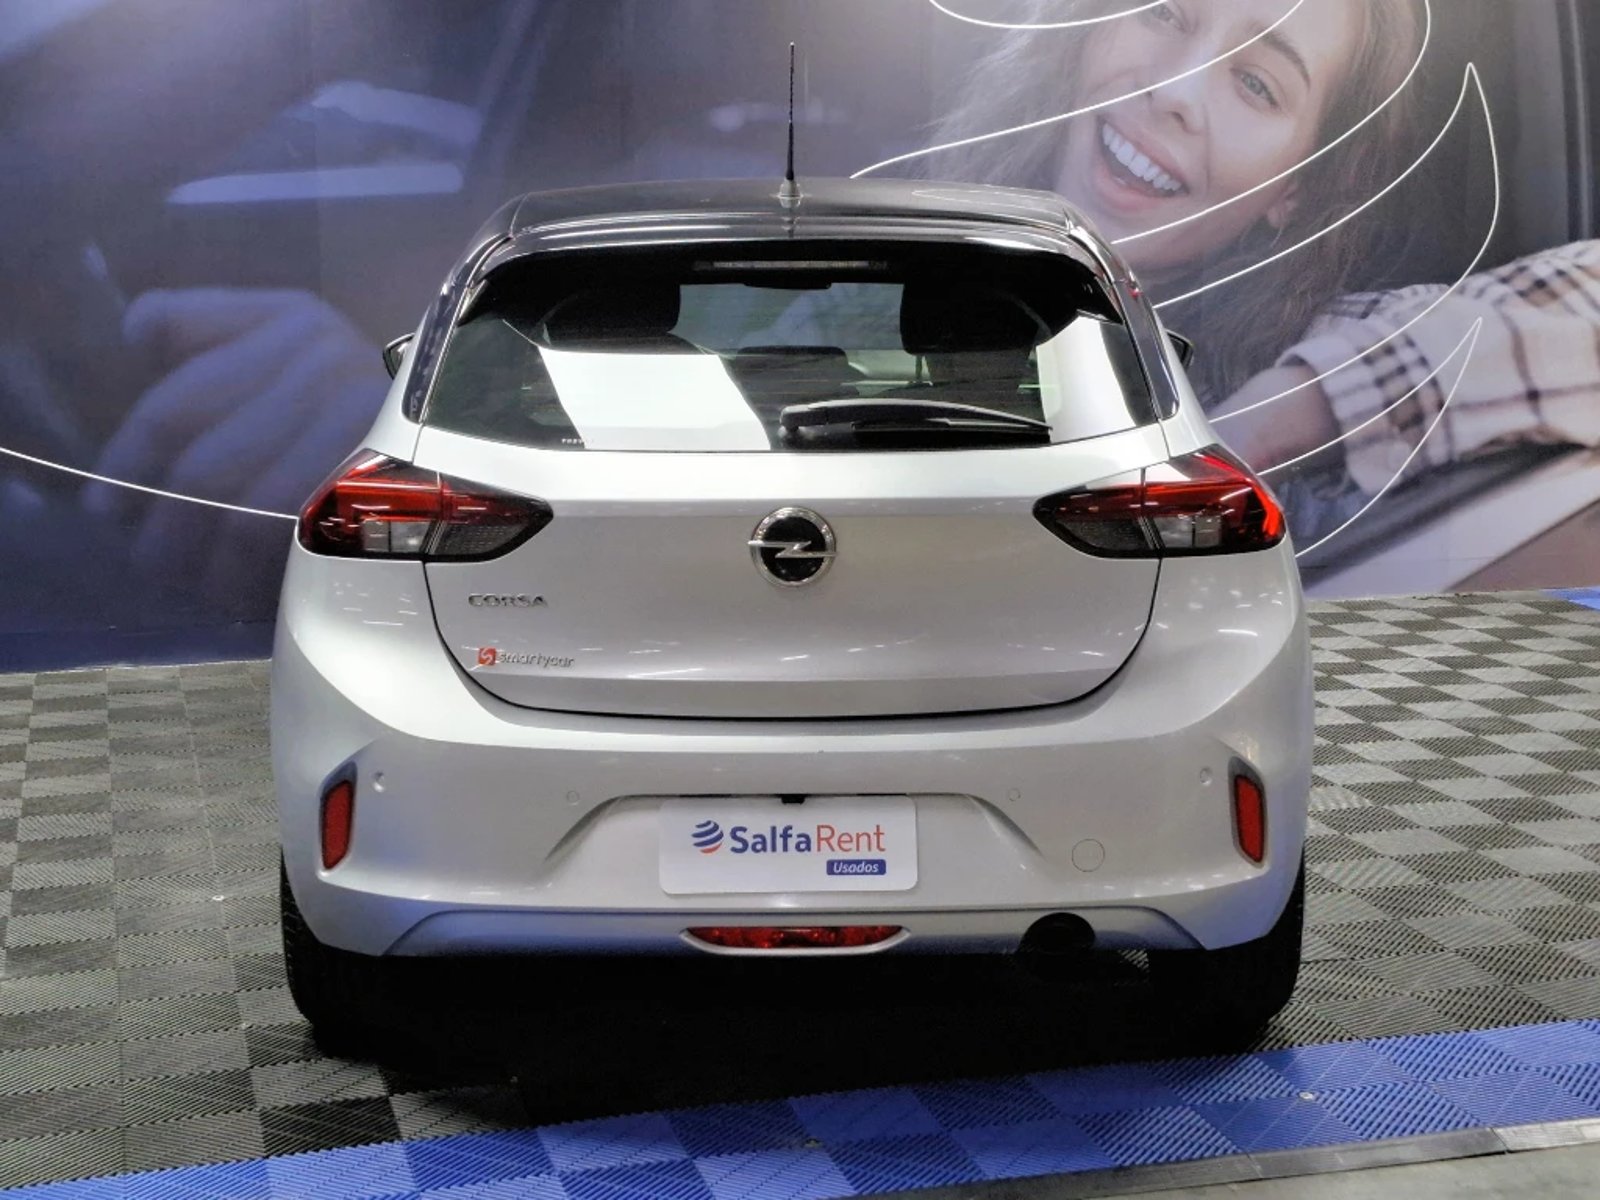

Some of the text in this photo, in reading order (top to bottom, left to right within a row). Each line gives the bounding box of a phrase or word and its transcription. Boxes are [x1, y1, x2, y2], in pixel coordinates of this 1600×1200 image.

[468, 593, 548, 607] CORSA
[499, 651, 575, 668] smartycar
[833, 861, 879, 874] Usados
